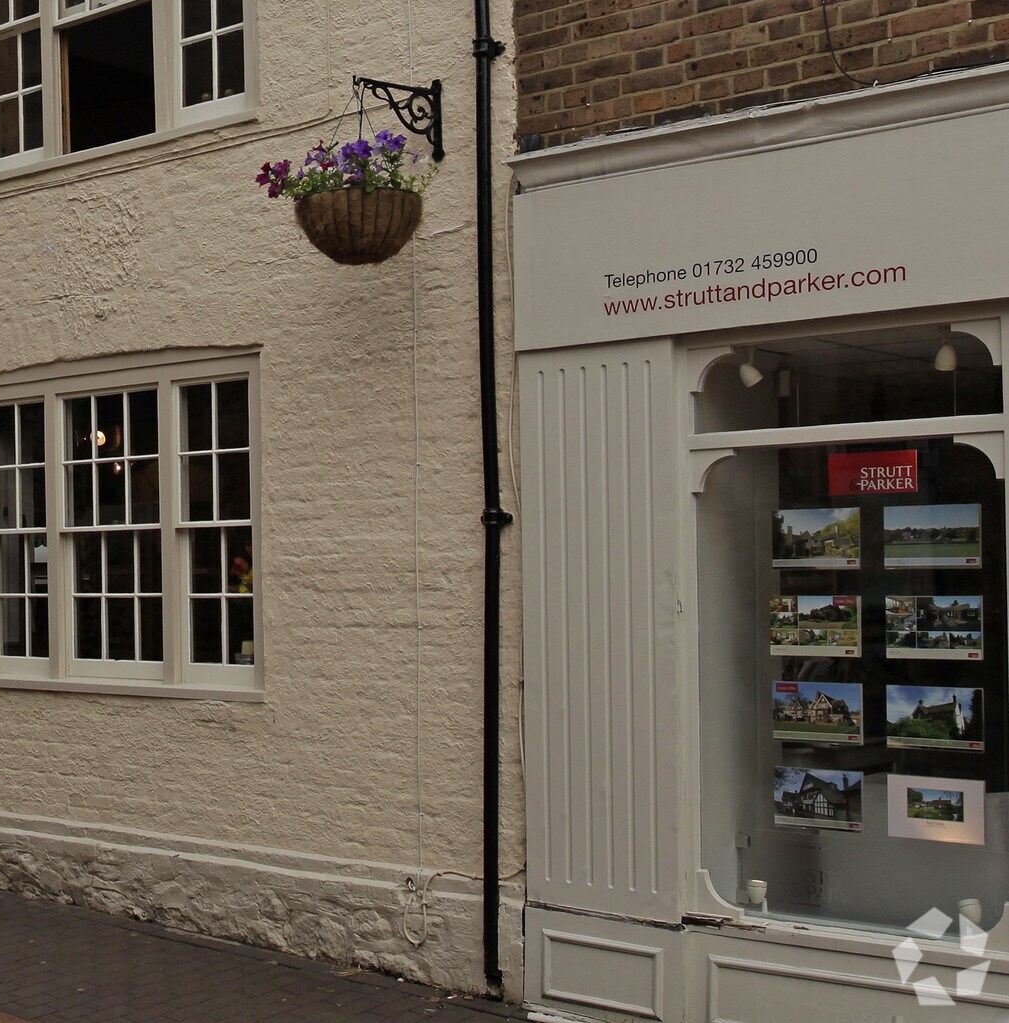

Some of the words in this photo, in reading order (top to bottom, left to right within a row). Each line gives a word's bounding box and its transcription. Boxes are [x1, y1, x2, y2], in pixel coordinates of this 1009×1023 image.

[604, 268, 687, 289] Telephone
[692, 257, 745, 278] 01732
[751, 248, 818, 270] 459900
[604, 265, 906, 316] www.struttandparker.com
[860, 465, 913, 479] STRUTT
